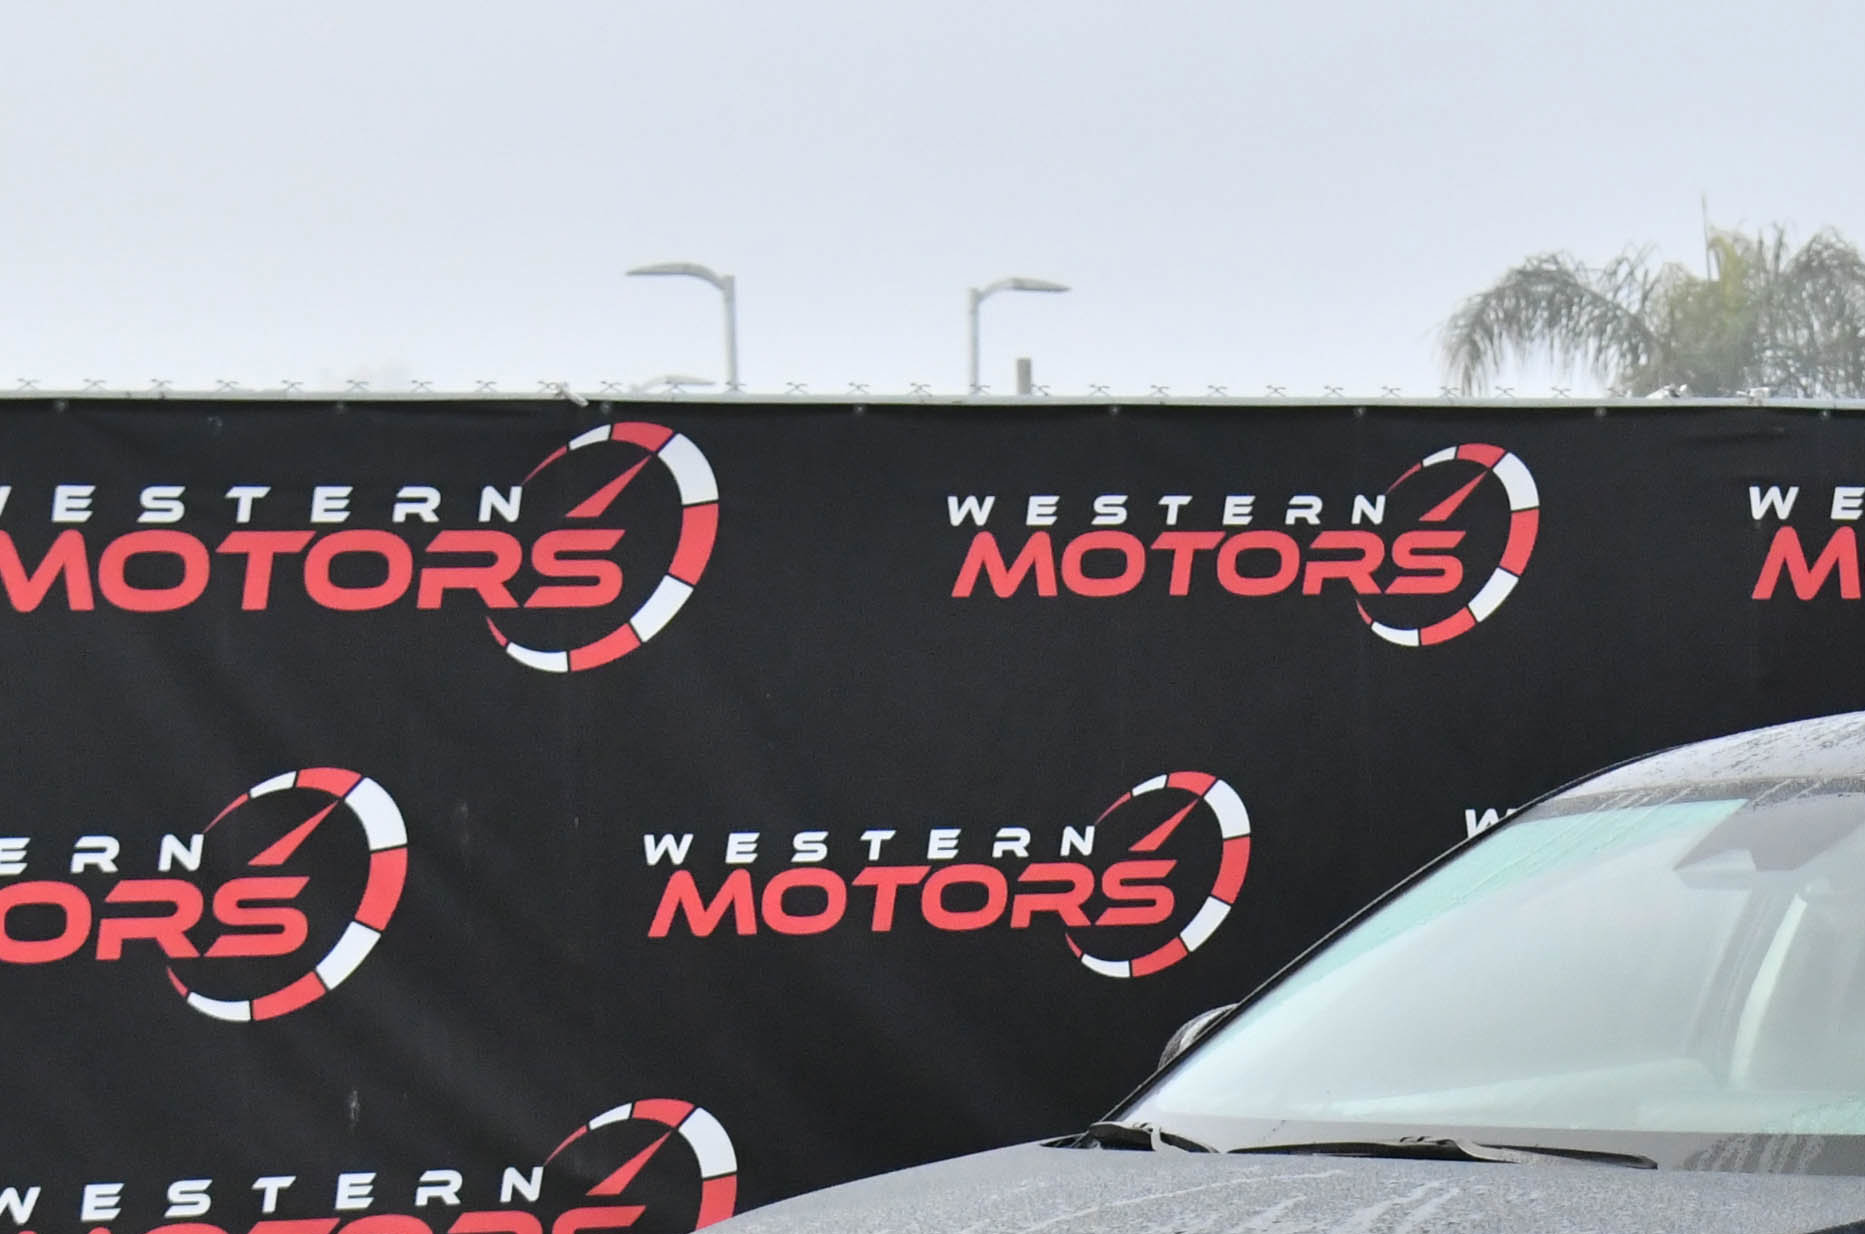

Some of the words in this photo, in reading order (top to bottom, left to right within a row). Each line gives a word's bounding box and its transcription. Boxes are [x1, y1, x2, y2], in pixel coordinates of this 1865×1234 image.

[0, 486, 522, 522] ESTERN
[948, 495, 1385, 526] WESTERN
[0, 529, 624, 612] MOTORS
[952, 530, 1466, 598] MOTORS
[644, 826, 1094, 865] WESTERN
[648, 860, 1177, 938] MOTORS
